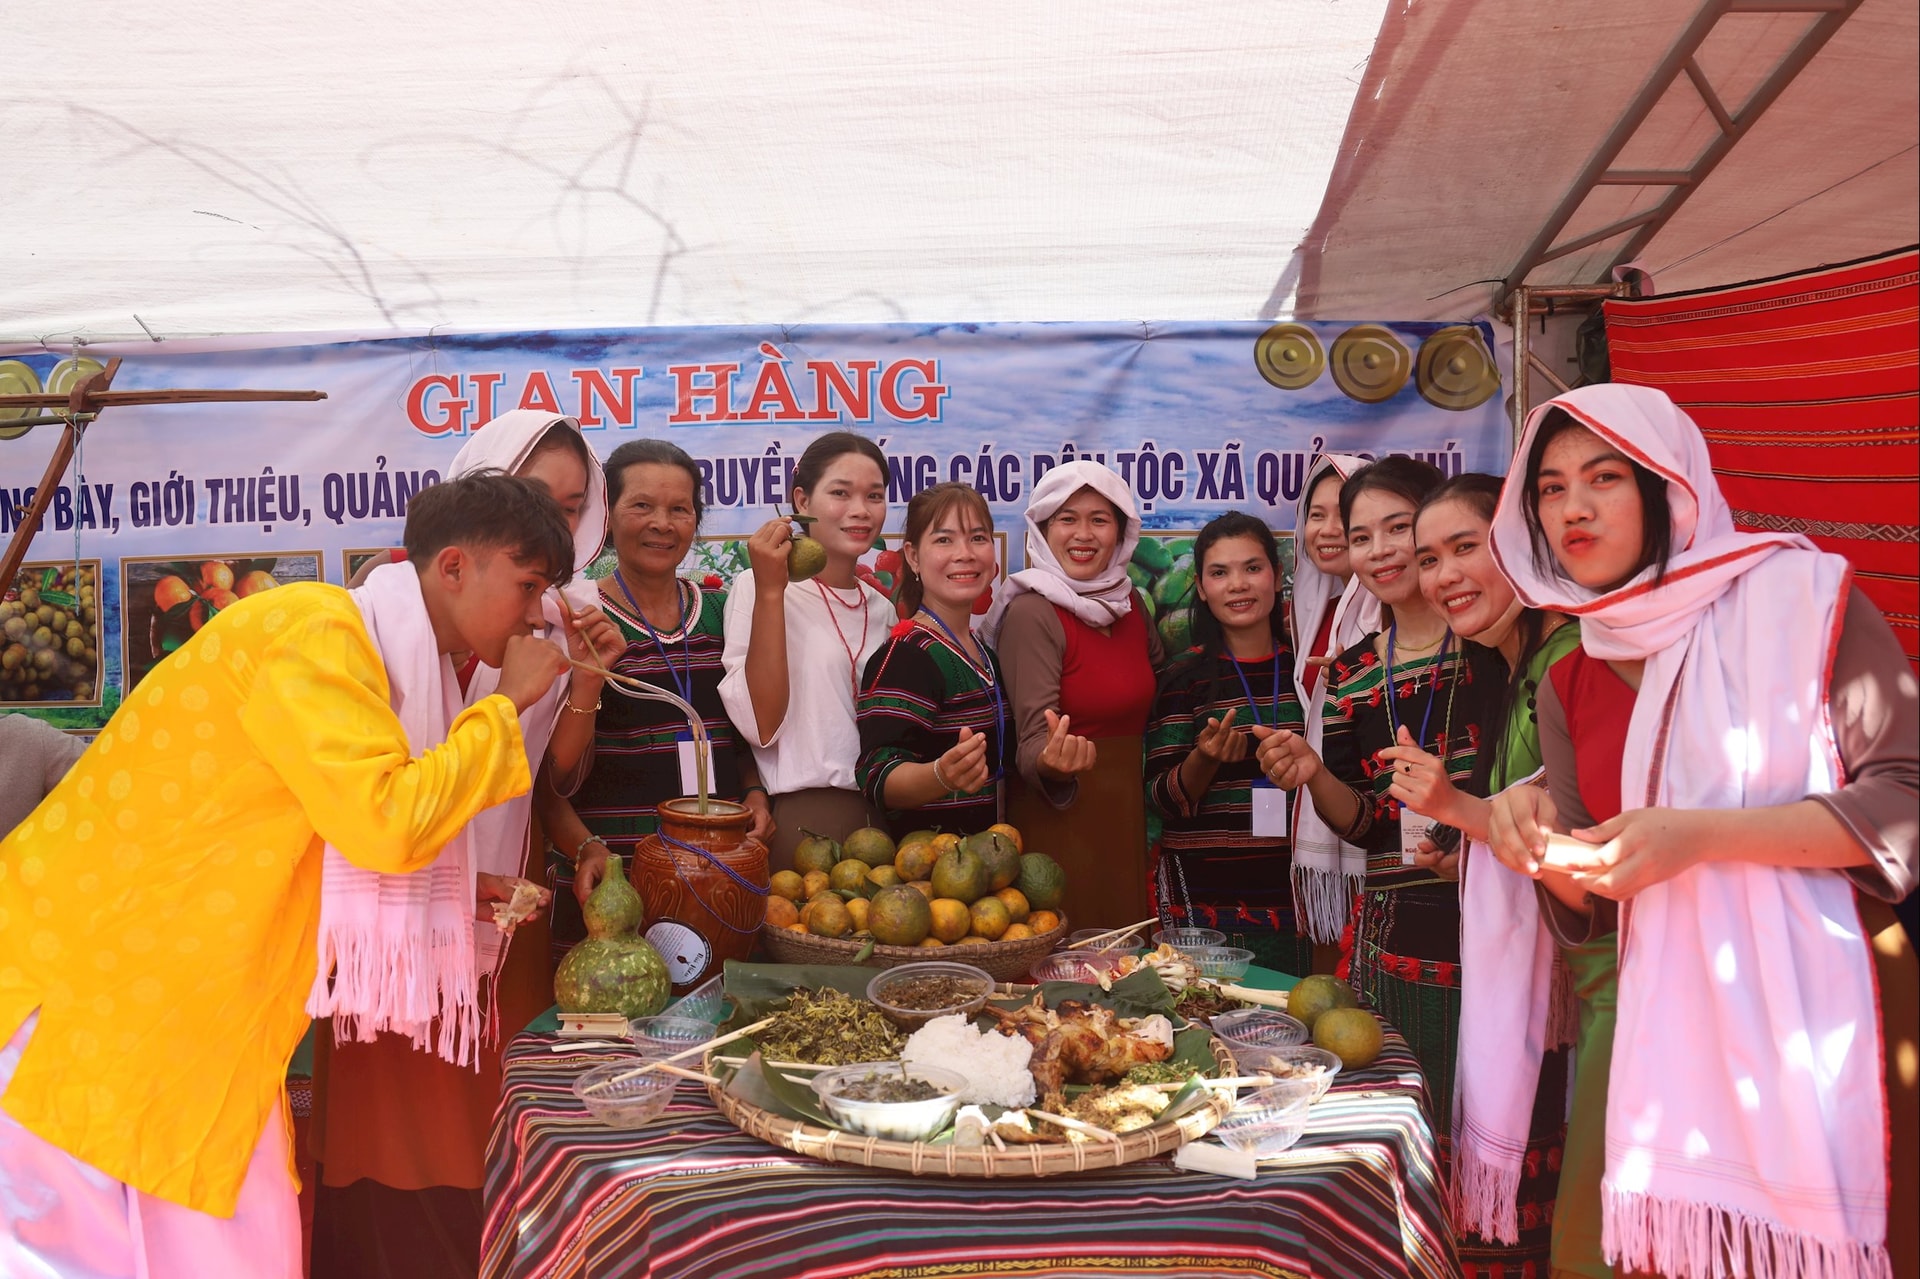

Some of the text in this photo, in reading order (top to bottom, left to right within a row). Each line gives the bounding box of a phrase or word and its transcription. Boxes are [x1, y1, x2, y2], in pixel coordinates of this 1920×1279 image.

[405, 341, 950, 438] GIAN HÀNG
[53, 474, 120, 535] BÀY,
[130, 468, 194, 527] GIỚI
[205, 465, 311, 533] THIỆU,
[949, 444, 1021, 502] CÁC
[1116, 441, 1185, 511] TỘC
[1197, 442, 1246, 501] XÃ
